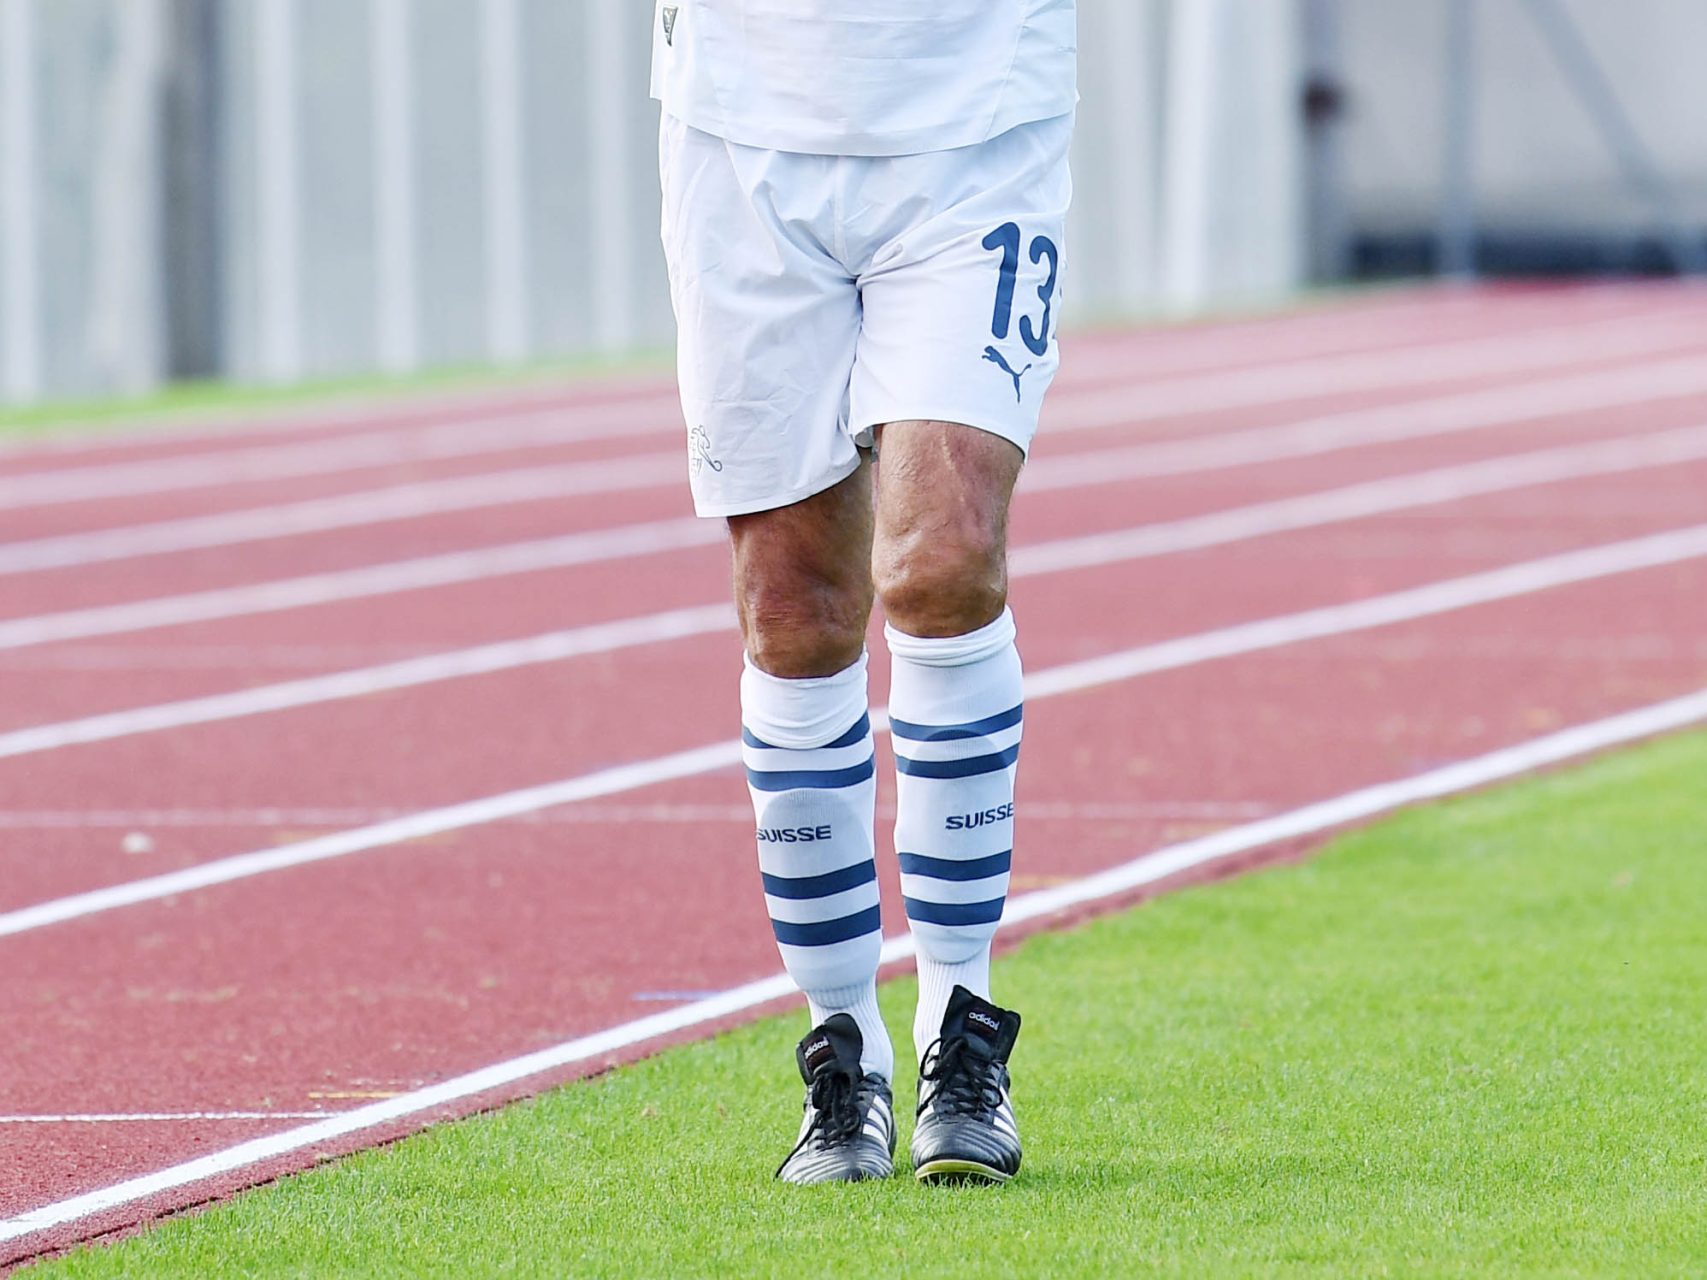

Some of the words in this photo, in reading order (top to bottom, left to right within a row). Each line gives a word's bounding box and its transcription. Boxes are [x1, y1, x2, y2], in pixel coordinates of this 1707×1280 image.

[981, 221, 1059, 357] 13
[945, 802, 1013, 830] SUISSE
[757, 825, 832, 843] SUISSE
